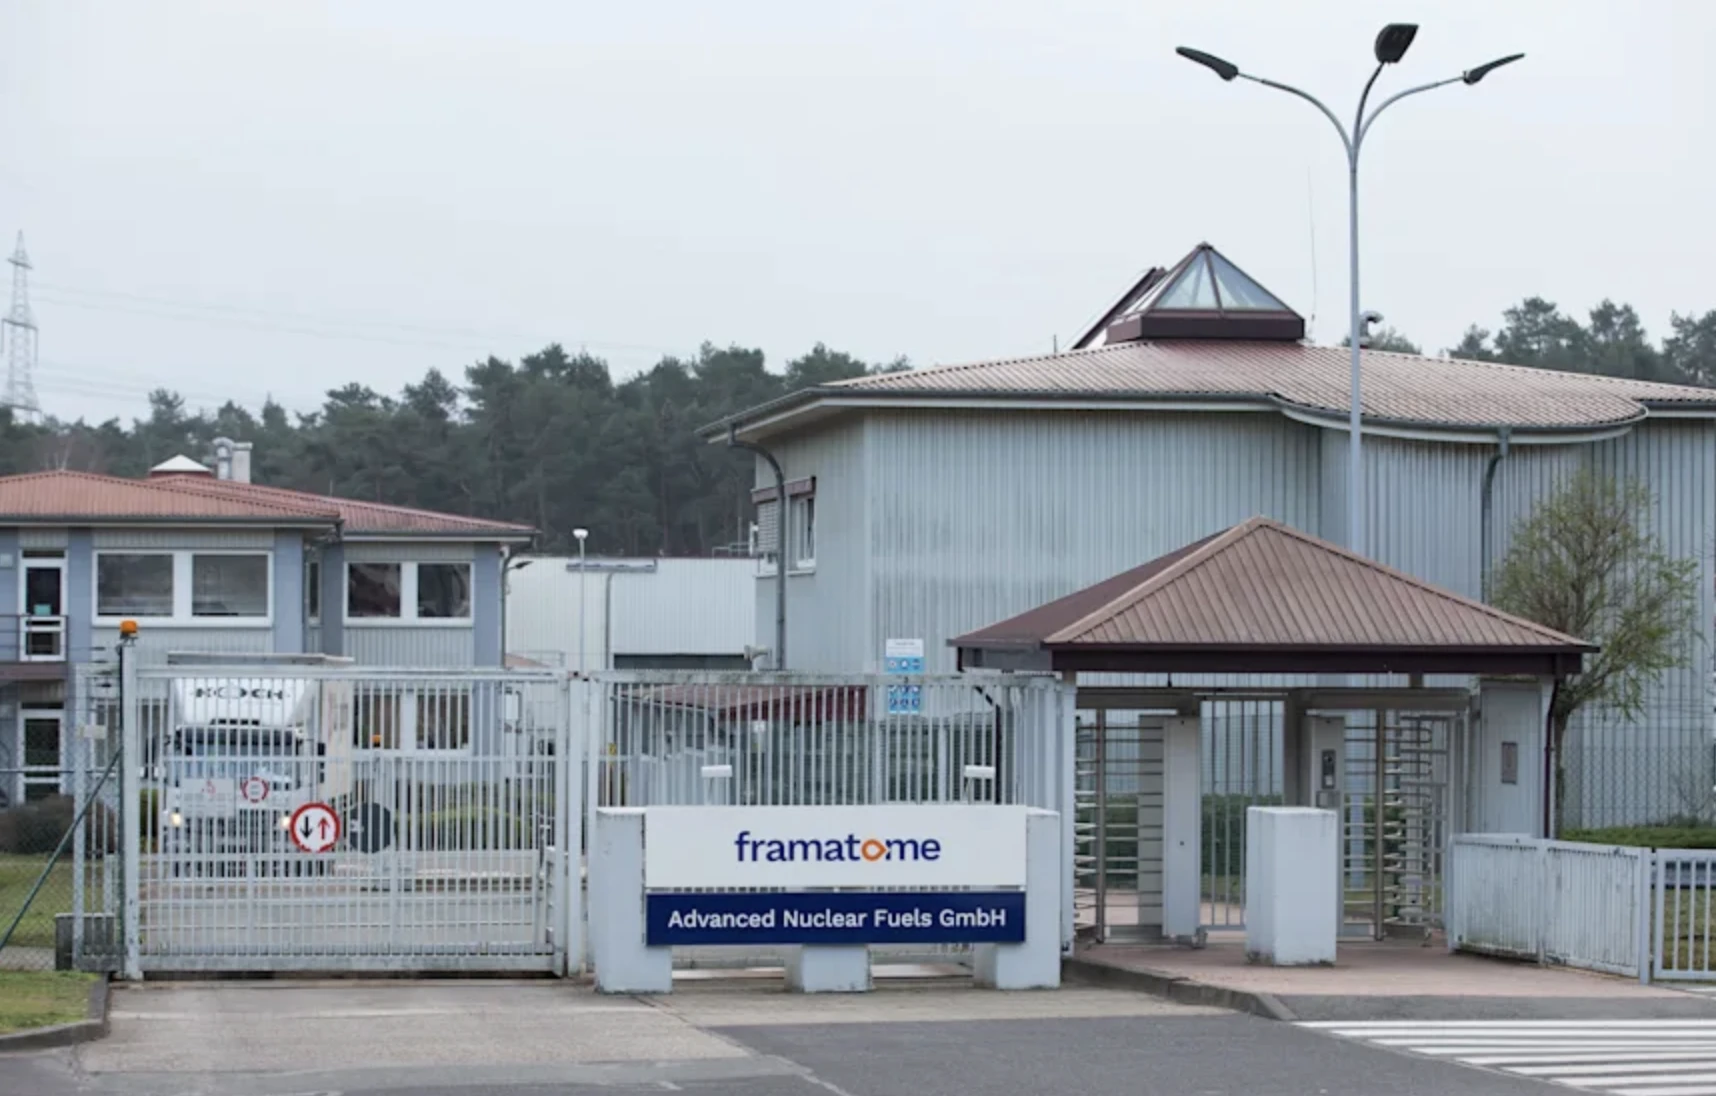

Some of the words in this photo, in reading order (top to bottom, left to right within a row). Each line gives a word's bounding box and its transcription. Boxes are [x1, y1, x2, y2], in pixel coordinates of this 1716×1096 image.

[735, 831, 941, 862] framatome
[668, 909, 775, 928] Advanced
[783, 909, 866, 928] Nuclear
[874, 908, 933, 928] Fuels
[939, 908, 1006, 928] GmbH
